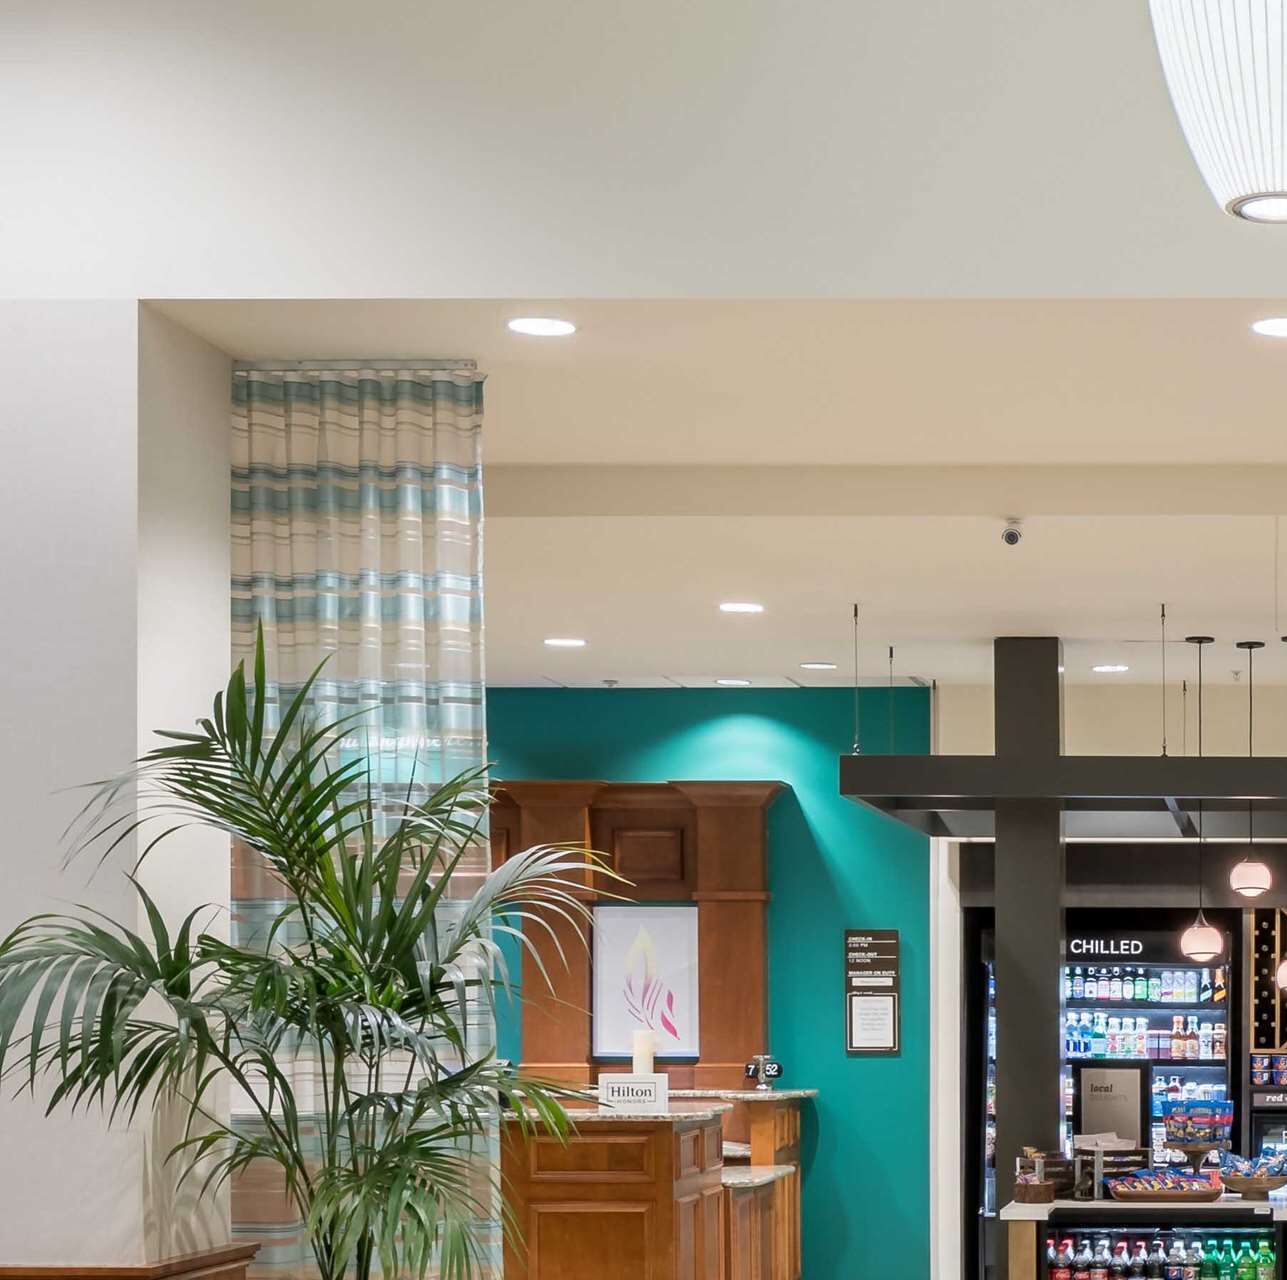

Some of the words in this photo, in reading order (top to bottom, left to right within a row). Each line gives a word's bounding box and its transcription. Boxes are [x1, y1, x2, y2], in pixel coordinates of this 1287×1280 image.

[1070, 939, 1143, 954] CHILLED
[747, 1066, 755, 1076] 7
[765, 1064, 778, 1076] 52
[611, 1086, 652, 1097] Hilton
[1090, 1083, 1113, 1093] local
[1266, 1094, 1283, 1102] red
